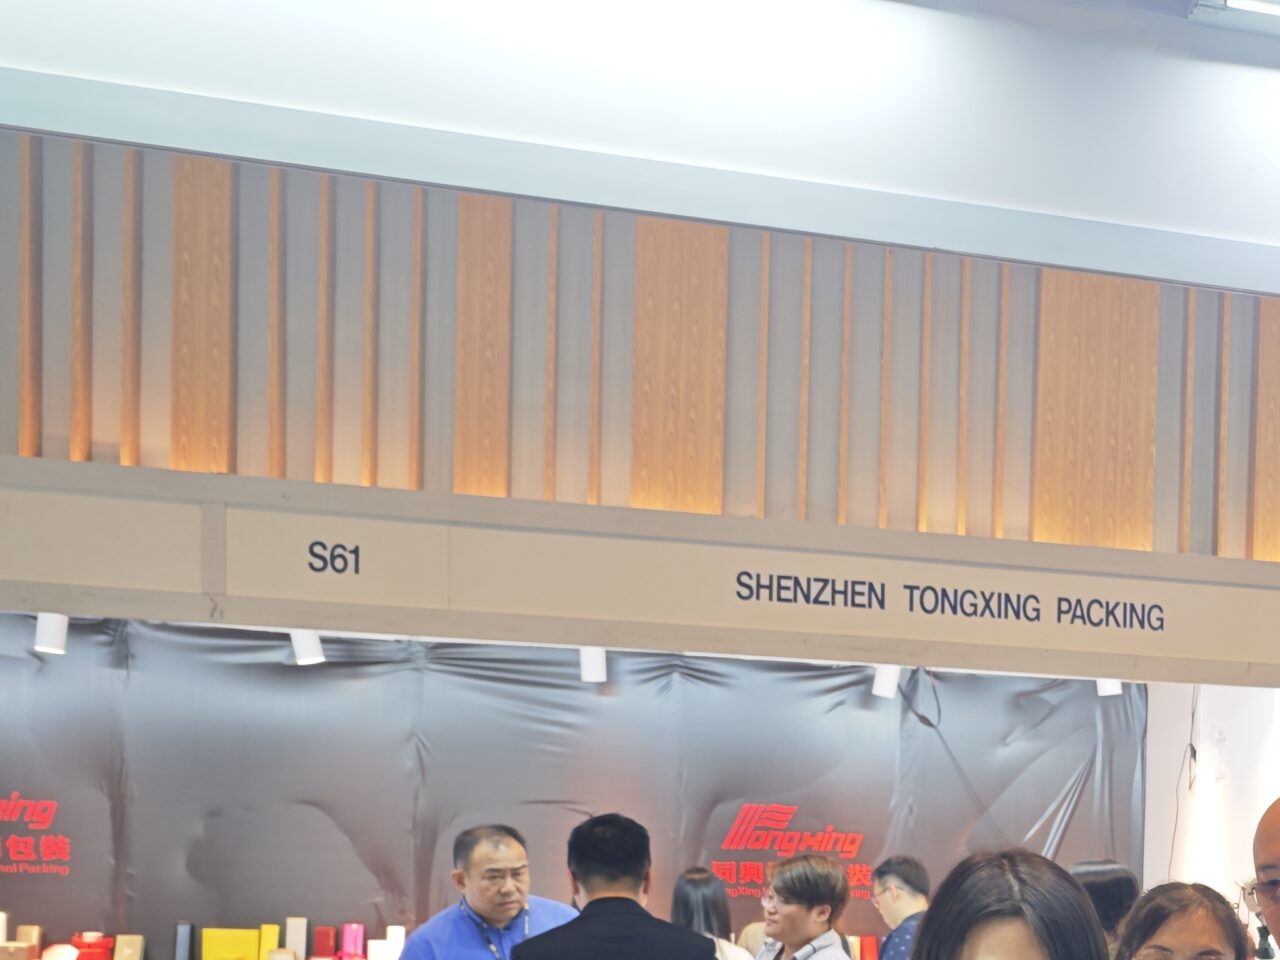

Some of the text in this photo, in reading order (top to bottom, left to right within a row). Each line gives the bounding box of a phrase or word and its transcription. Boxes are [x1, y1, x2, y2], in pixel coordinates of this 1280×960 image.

[308, 540, 360, 575] S61
[735, 570, 1165, 631] SHENZHEN TONGXING PACKING
